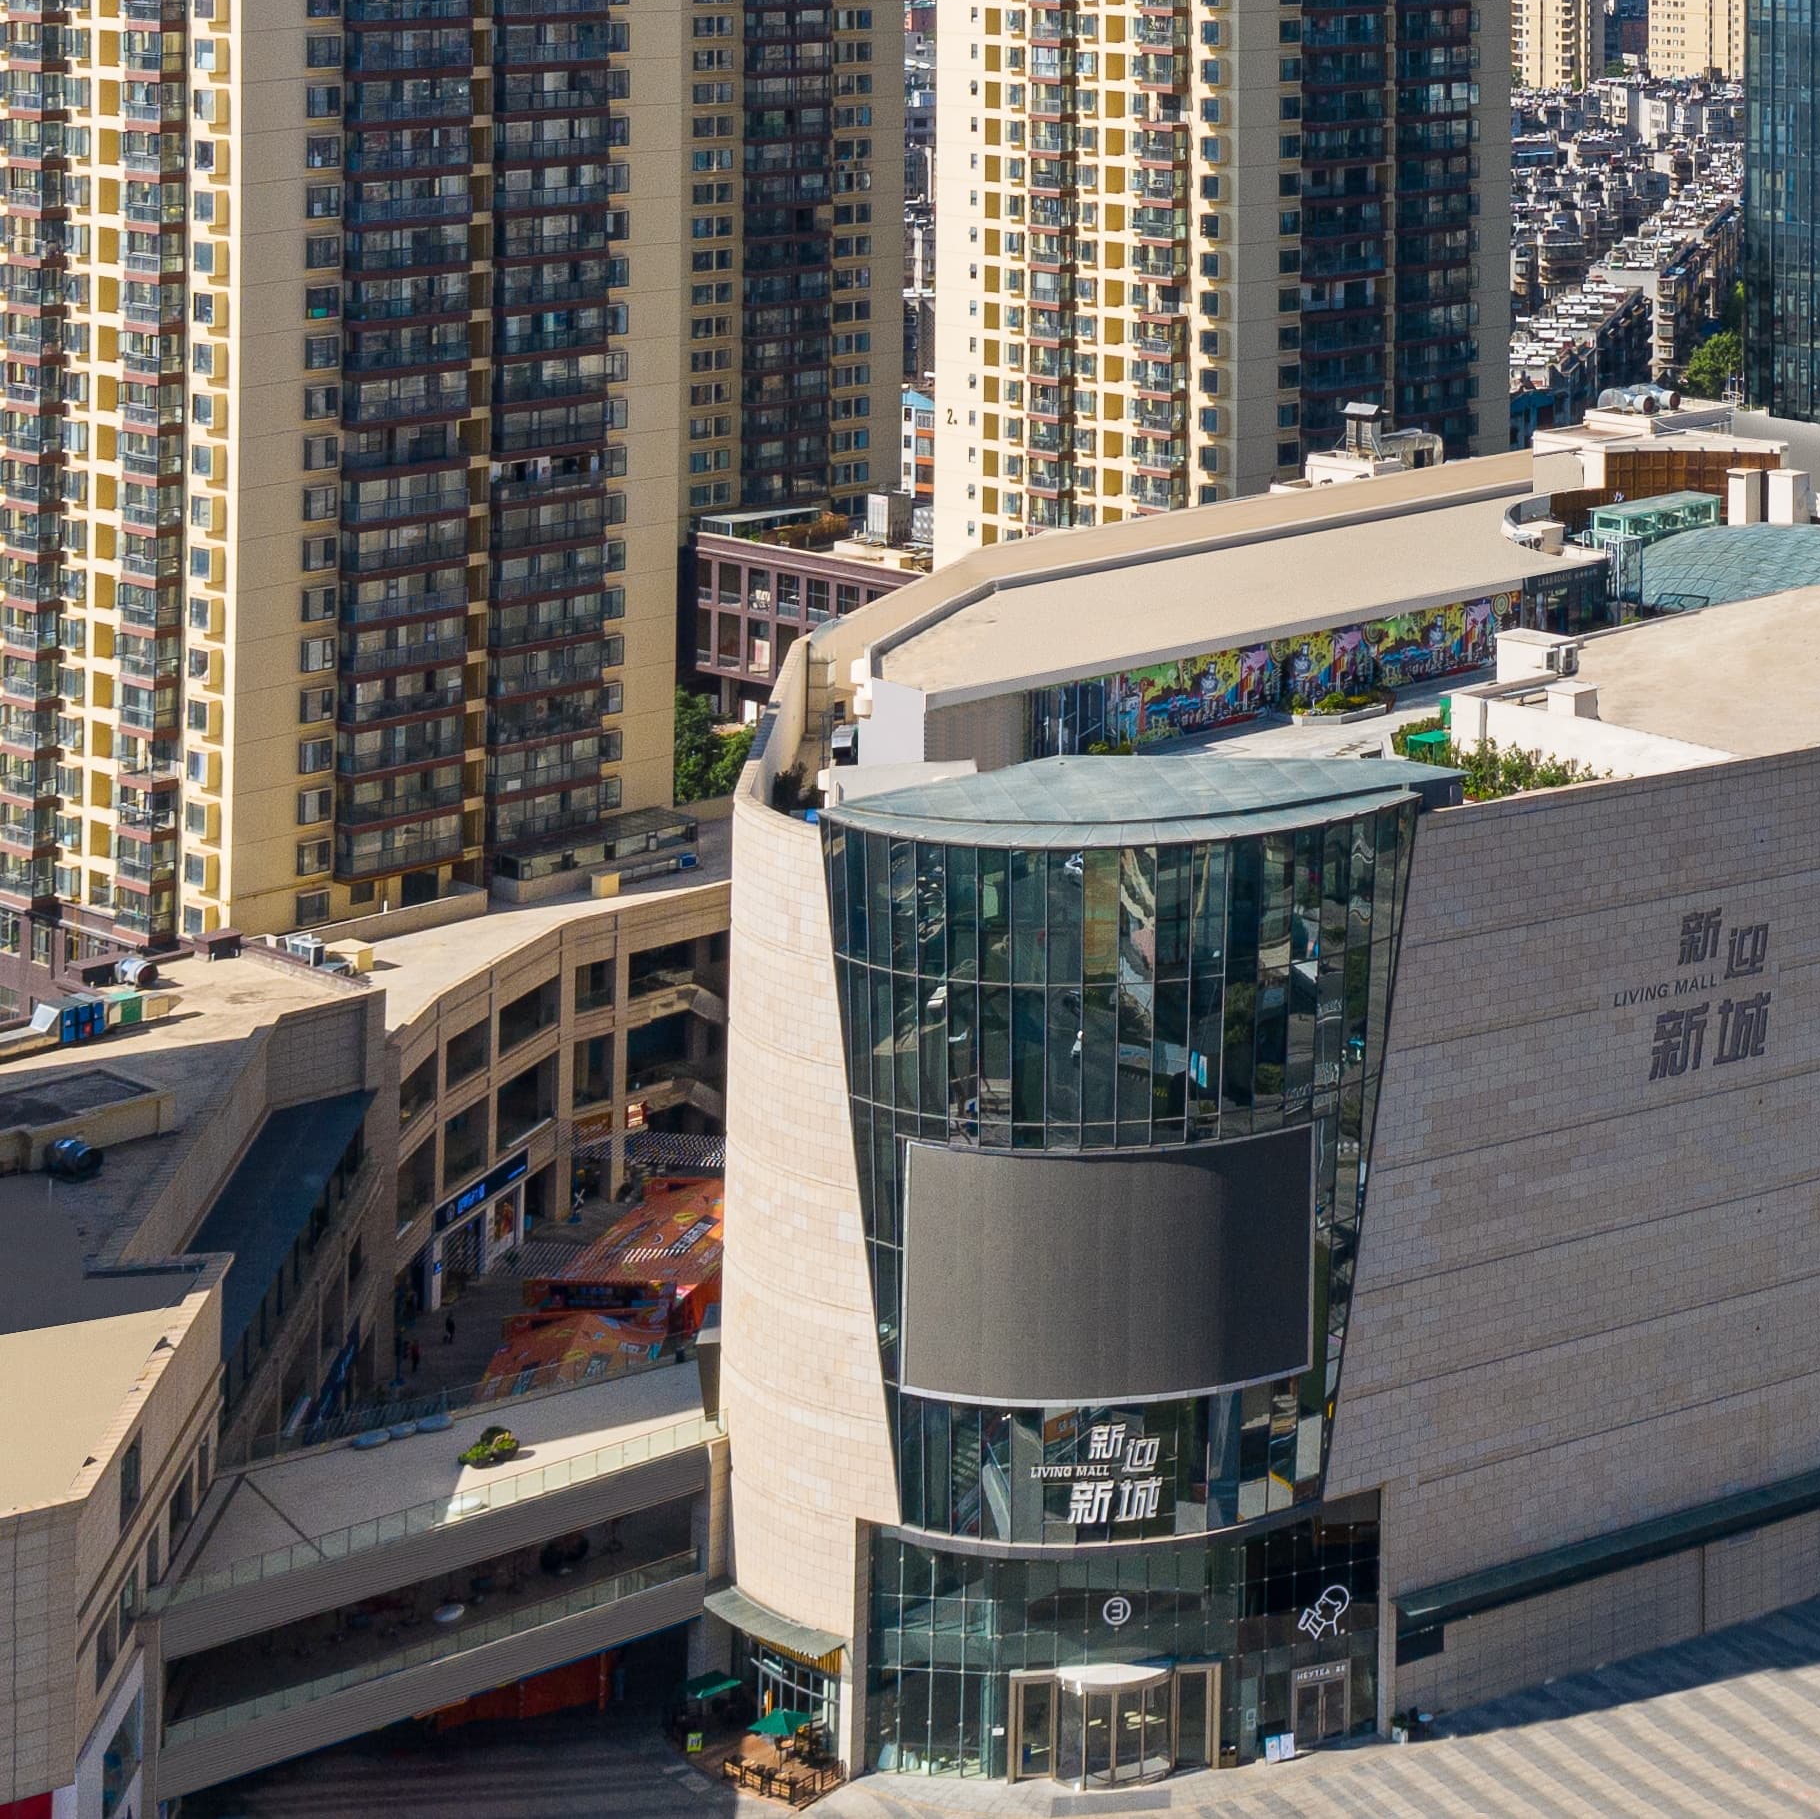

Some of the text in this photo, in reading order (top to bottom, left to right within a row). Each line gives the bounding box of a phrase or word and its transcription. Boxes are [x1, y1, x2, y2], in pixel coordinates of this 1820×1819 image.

[1678, 907, 1769, 980] 新迎
[1614, 975, 1718, 1007] LIVING MALL
[1649, 992, 1771, 1080] 新城
[1030, 1464, 1110, 1479] LIVING MALL
[1088, 1422, 1161, 1472] 新迎
[1067, 1476, 1163, 1524] 新城
